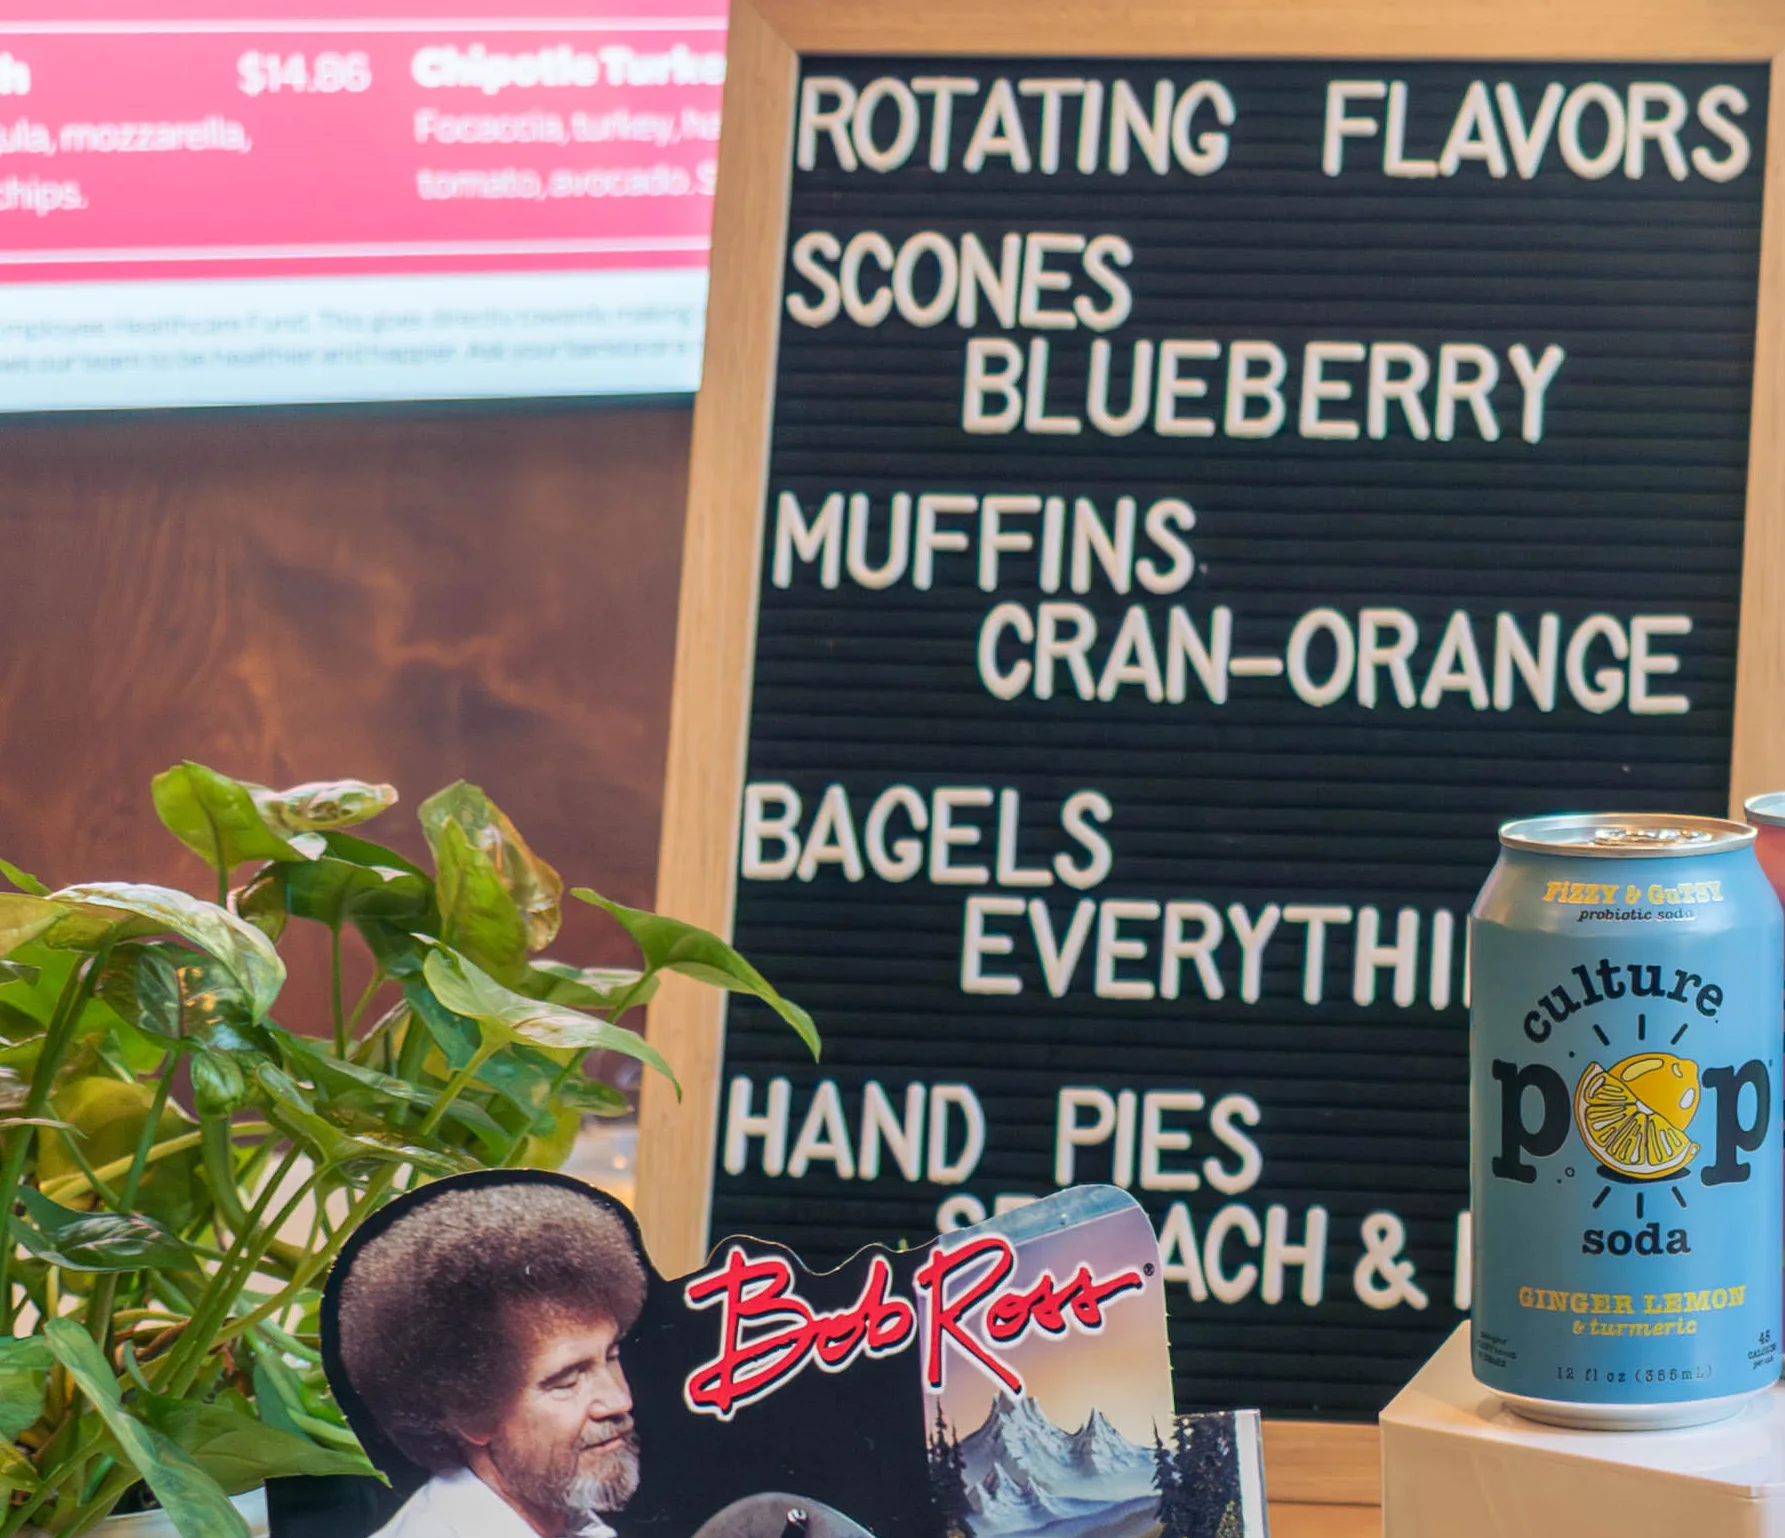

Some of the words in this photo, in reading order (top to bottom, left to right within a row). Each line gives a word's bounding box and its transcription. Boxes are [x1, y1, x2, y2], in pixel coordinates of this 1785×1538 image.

[797, 78, 1236, 175] ROTATING
[1323, 80, 1749, 182] FLAVORS
[786, 231, 1133, 329] SCONES
[961, 338, 1564, 443] BLUEBERRY
[772, 492, 1196, 593] MUFFINS
[977, 602, 1691, 714] CRAN-ORANGE
[741, 783, 1112, 889] BAGELS
[960, 897, 1470, 1010] EVERYTHI
[1577, 908, 1652, 922] probiotic
[1656, 908, 1695, 921] soda
[1524, 958, 1724, 1042] culture
[723, 1076, 986, 1184] HAND
[1055, 1087, 1263, 1196] PIES
[1354, 1211, 1427, 1310] &
[1582, 1223, 1691, 1256] soda
[686, 1247, 915, 1417] Bob
[917, 1237, 1144, 1395] Ross
[1519, 1286, 1633, 1314] GINGER
[1644, 1285, 1746, 1314] LEMON
[1573, 1320, 1585, 1336] &
[1589, 1317, 1697, 1336] turmeric
[1557, 1366, 1574, 1380] 12
[1585, 1366, 1597, 1381] fl
[1606, 1370, 1625, 1383] oz
